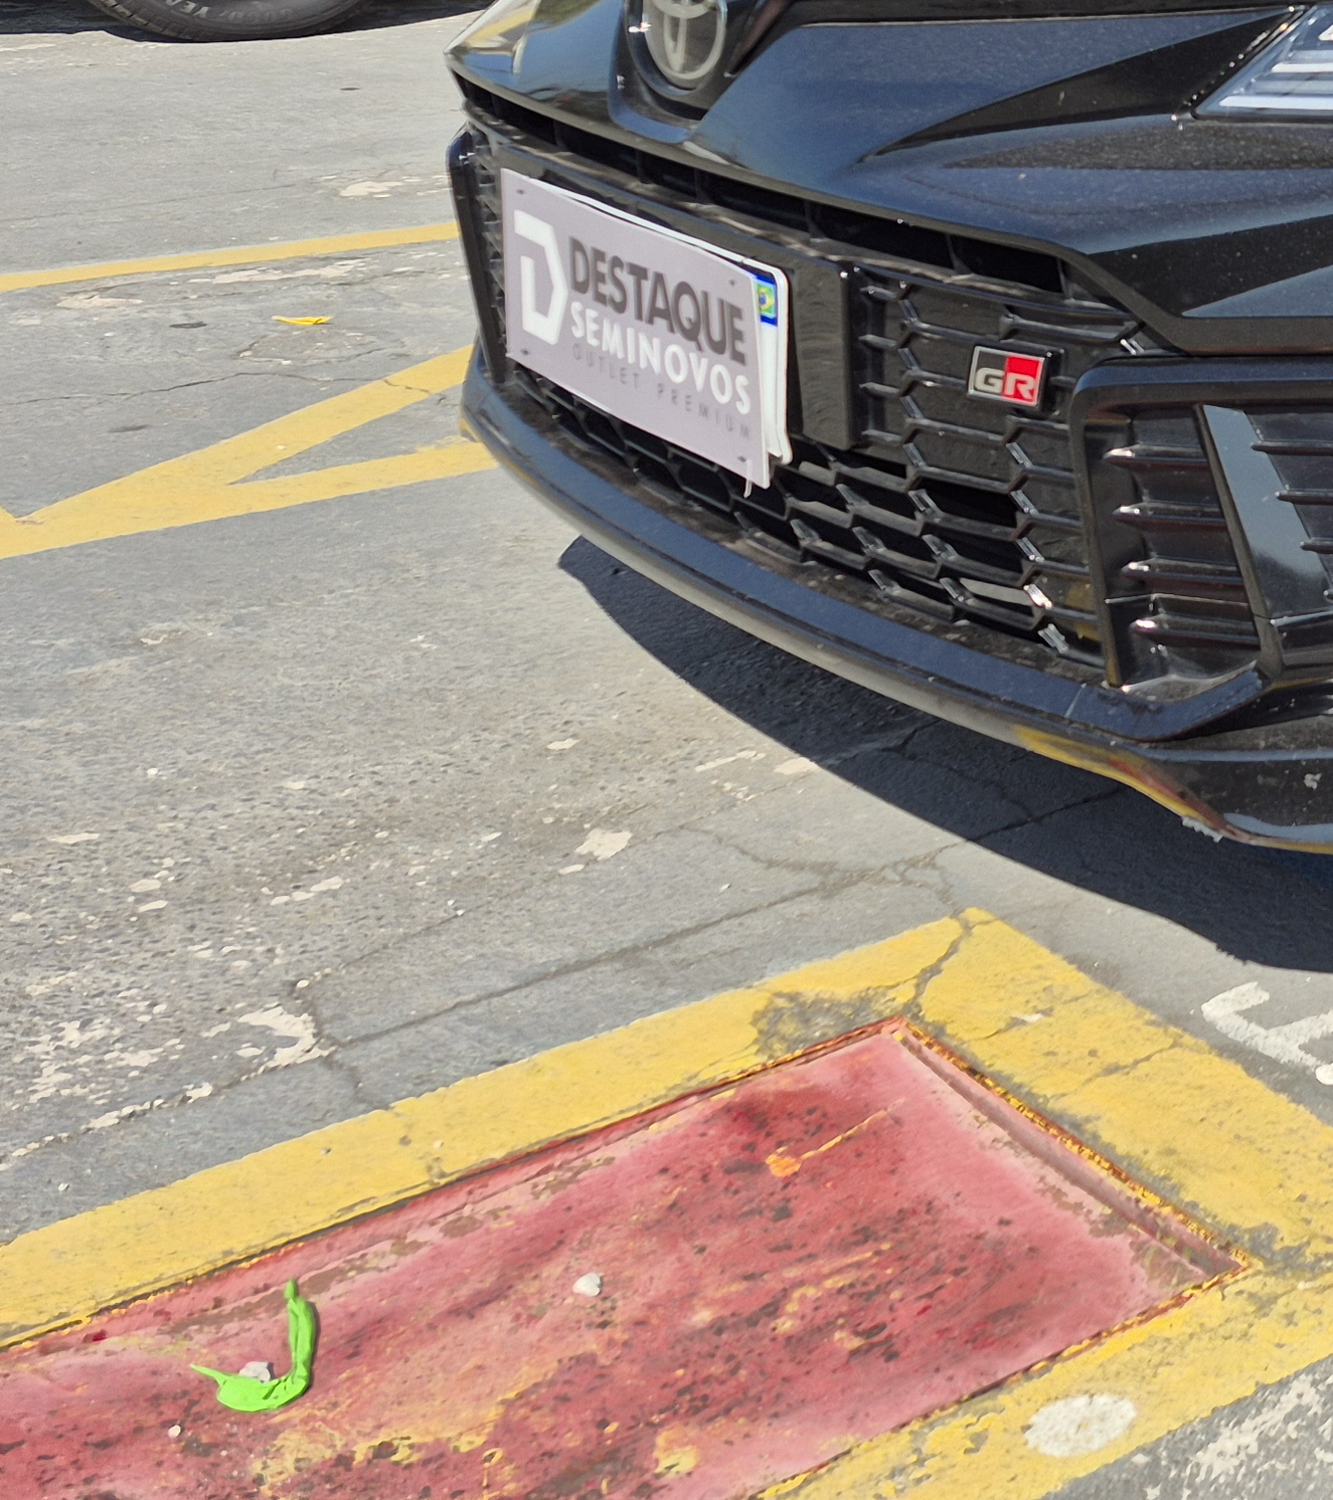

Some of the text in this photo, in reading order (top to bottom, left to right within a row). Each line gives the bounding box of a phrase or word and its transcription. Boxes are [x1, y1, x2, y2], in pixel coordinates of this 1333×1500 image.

[569, 236, 746, 366] DESTAQUE
[570, 301, 751, 415] SEMINOVOS
[572, 343, 750, 439] OUTLET PREMIUM
[975, 367, 1037, 401] GR
